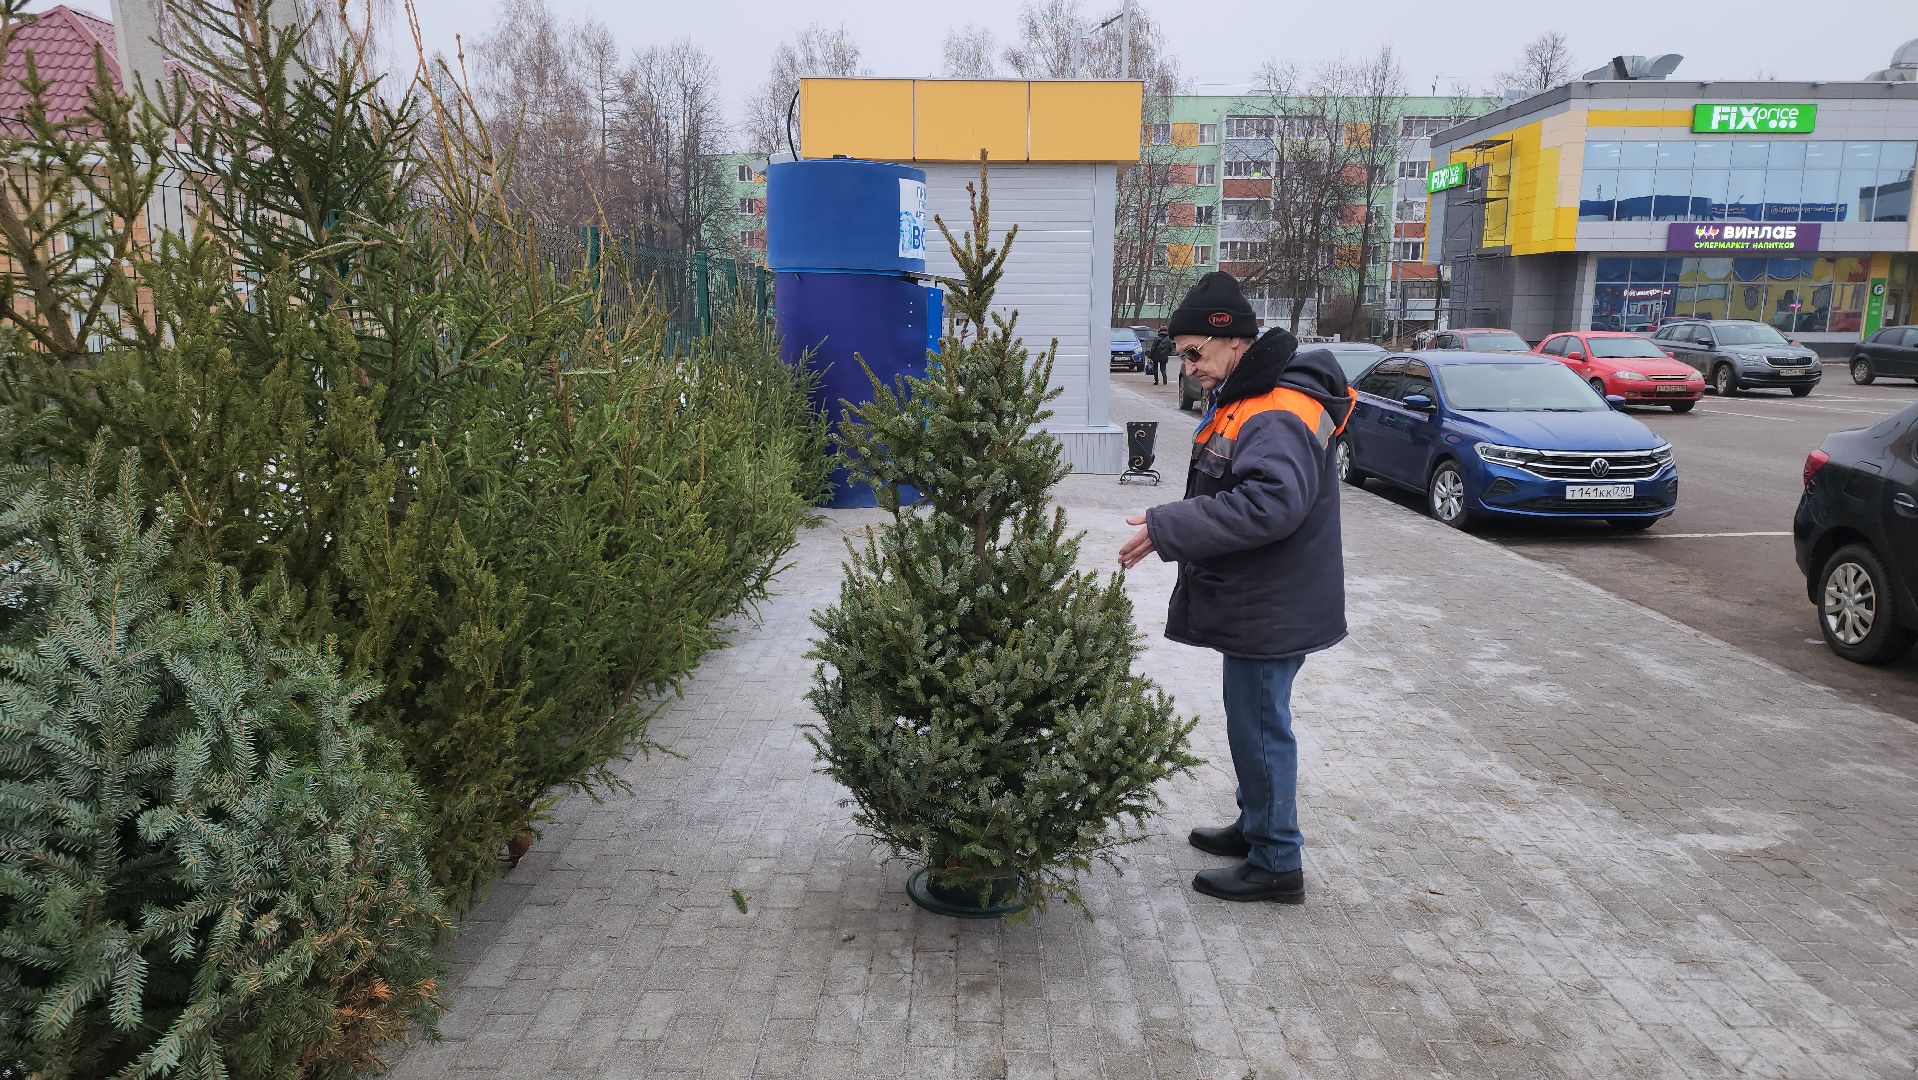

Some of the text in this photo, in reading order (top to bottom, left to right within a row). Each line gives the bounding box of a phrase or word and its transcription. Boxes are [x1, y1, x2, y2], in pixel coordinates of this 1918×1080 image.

[1757, 107, 1799, 123] price
[1723, 225, 1797, 240] ВИНЛАБ
[1694, 241, 1795, 249] СУПЕРМАРКЕТ НАПИТКОВ
